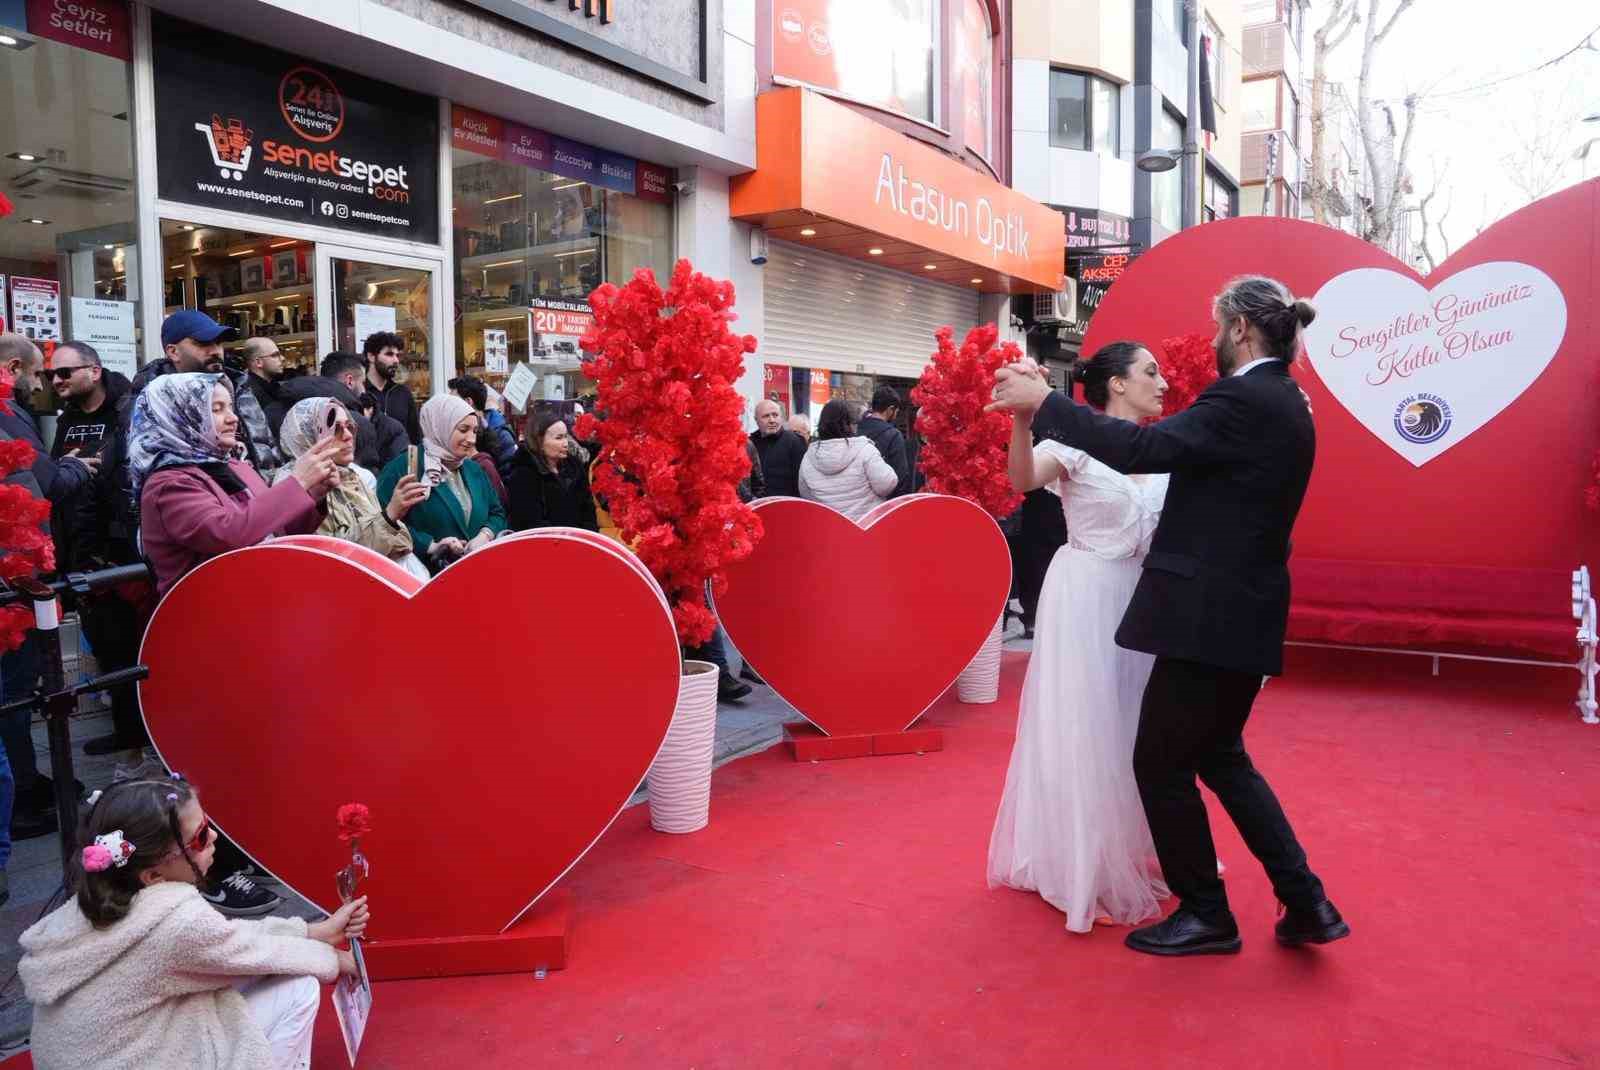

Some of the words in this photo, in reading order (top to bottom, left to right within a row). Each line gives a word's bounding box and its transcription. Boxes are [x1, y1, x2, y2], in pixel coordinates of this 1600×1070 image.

[54, 0, 107, 24] Çeyiz
[49, 12, 112, 42] Setleri
[293, 113, 333, 134] Alışveriş
[520, 135, 532, 146] Ev
[262, 140, 409, 190] senetsepet
[263, 167, 305, 182] Alışverişin
[306, 175, 317, 184] en
[318, 178, 339, 192] kolay
[340, 181, 364, 194] adresi
[197, 182, 304, 208] www.senetsepet.com
[351, 209, 410, 226] senetsepetcom
[875, 153, 968, 239] Atasun
[976, 197, 1029, 262] Optik
[1104, 255, 1128, 267] CEP
[1082, 267, 1125, 280] AKSES
[532, 298, 547, 308] TÜM
[536, 311, 557, 332] 20
[1331, 313, 1433, 359] Sevgililer
[1433, 284, 1534, 336] Gününüz
[1366, 344, 1441, 386] Kutlu
[1443, 329, 1513, 360] Olsun
[1394, 395, 1416, 417] KARTAL
[1418, 393, 1452, 418] BELEDİYESİ
